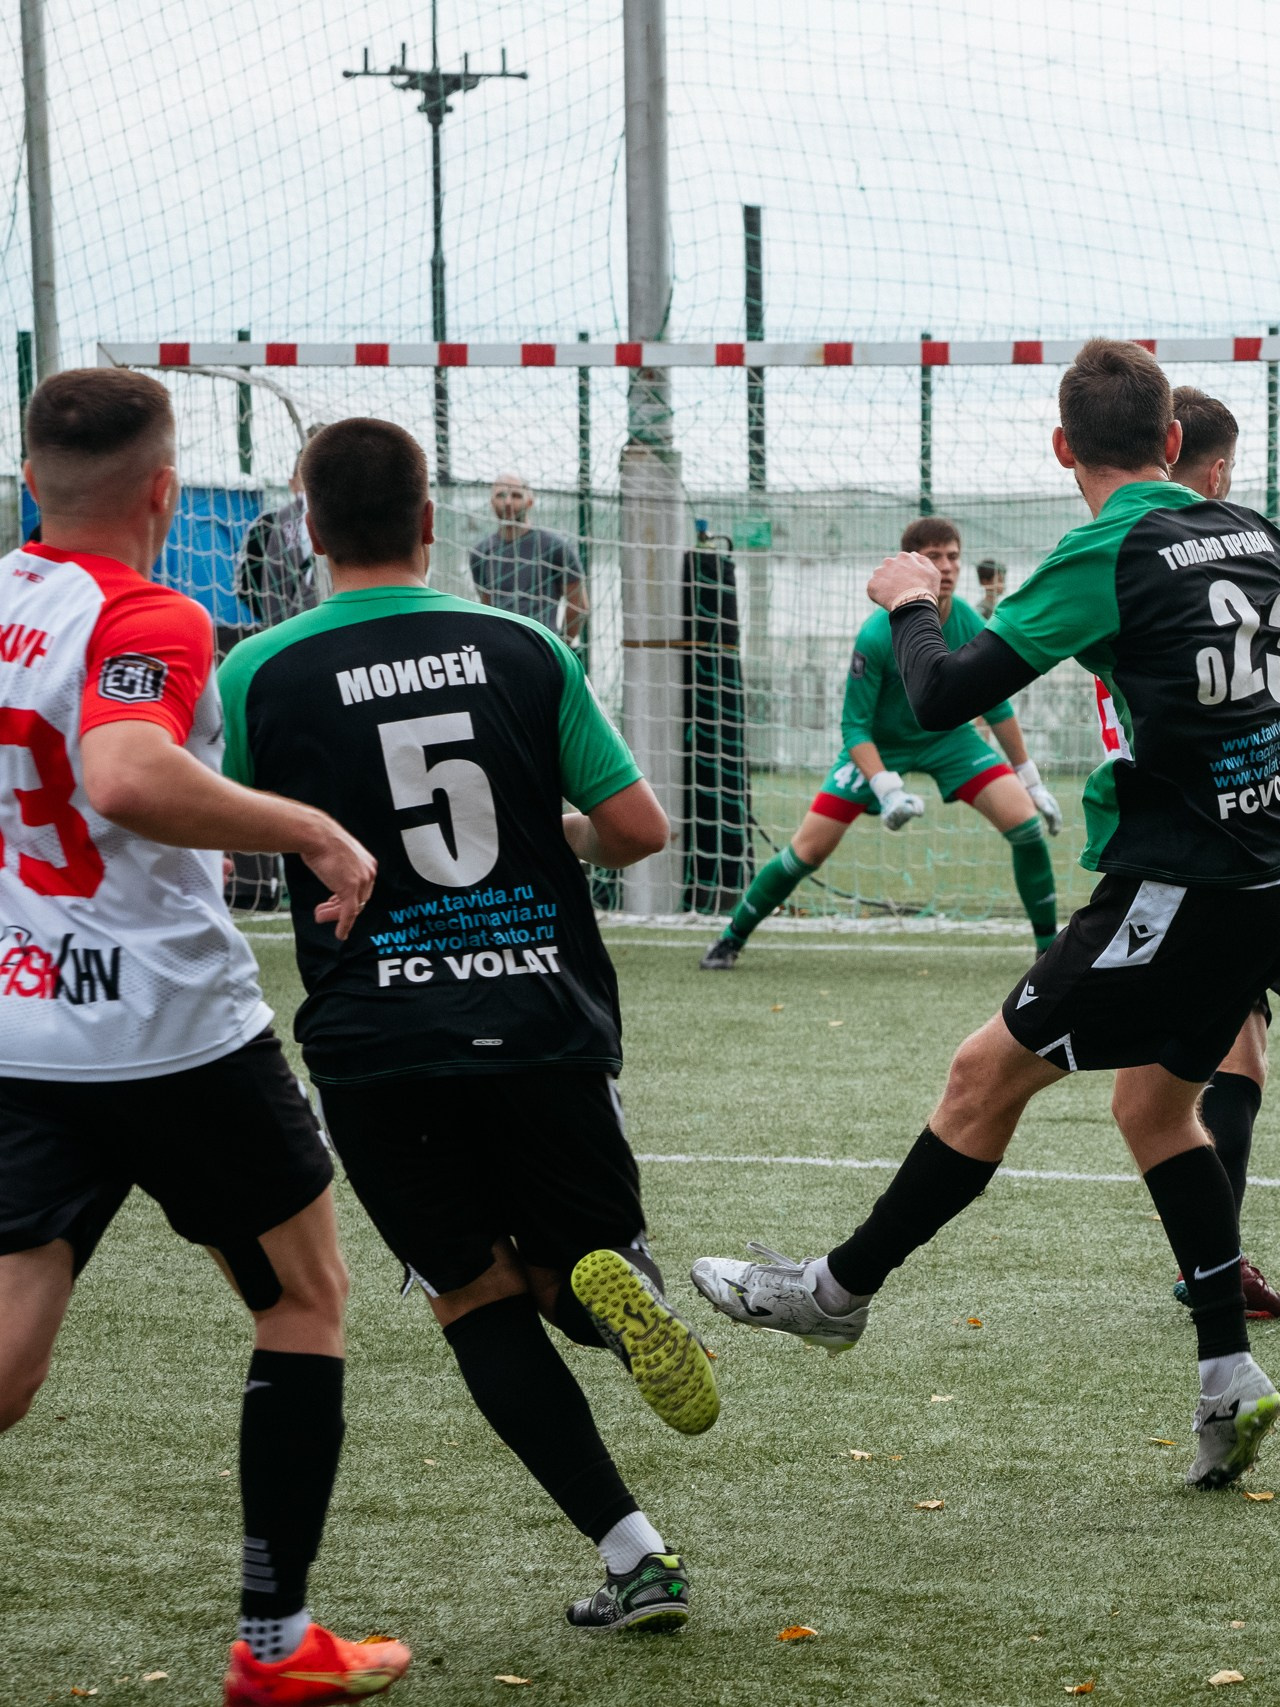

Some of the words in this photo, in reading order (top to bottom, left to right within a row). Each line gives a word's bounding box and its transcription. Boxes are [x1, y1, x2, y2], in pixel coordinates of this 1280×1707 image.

[1157, 536, 1226, 571] ТОЛЬКО
[336, 645, 487, 705] МОИСЕЙ
[0, 706, 105, 898] 3
[378, 711, 499, 887] 5
[1217, 788, 1260, 820] FC
[377, 956, 434, 987] FC
[443, 946, 561, 980] VOLAT
